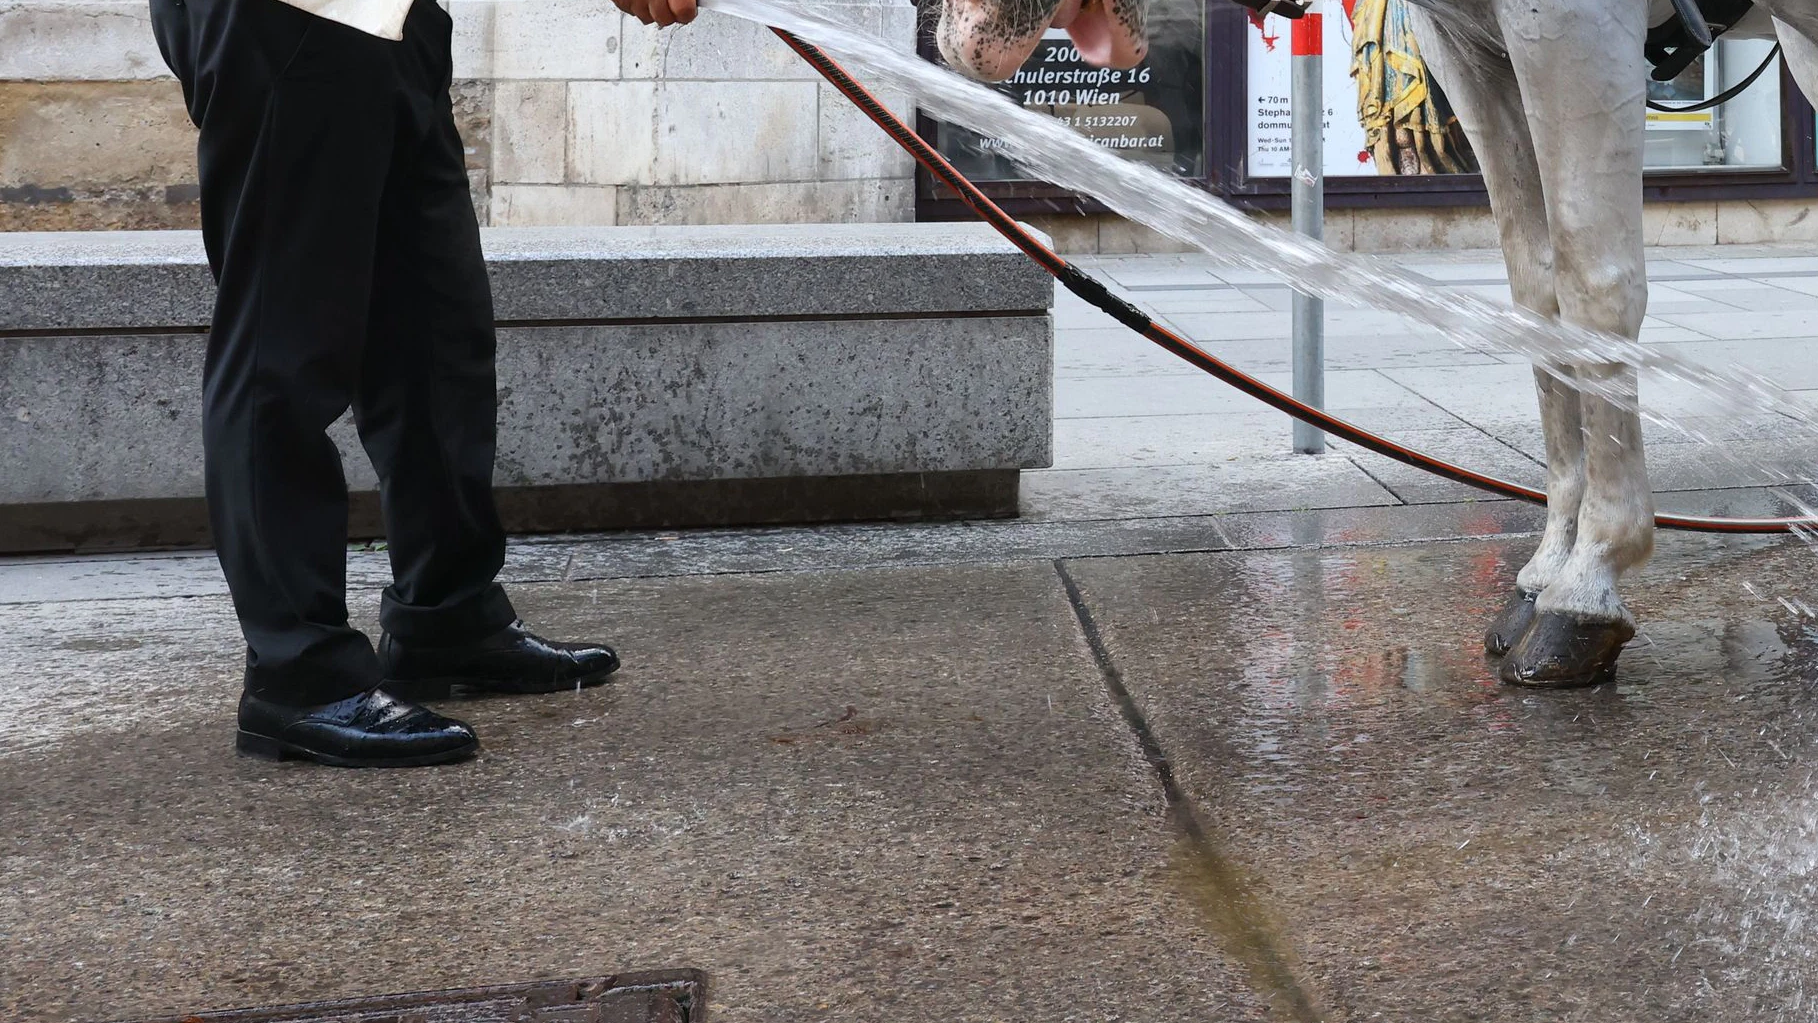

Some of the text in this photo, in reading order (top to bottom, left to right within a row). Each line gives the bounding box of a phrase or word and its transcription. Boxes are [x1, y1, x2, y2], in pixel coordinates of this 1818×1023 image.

[1045, 46, 1086, 63] 200
[1005, 66, 1151, 87] chulerstraße 16
[1023, 89, 1120, 105] 1010 Wien
[1267, 96, 1279, 104] 70
[1327, 108, 1334, 116] 6
[1074, 116, 1080, 127] 1
[1084, 115, 1137, 127] 5132207
